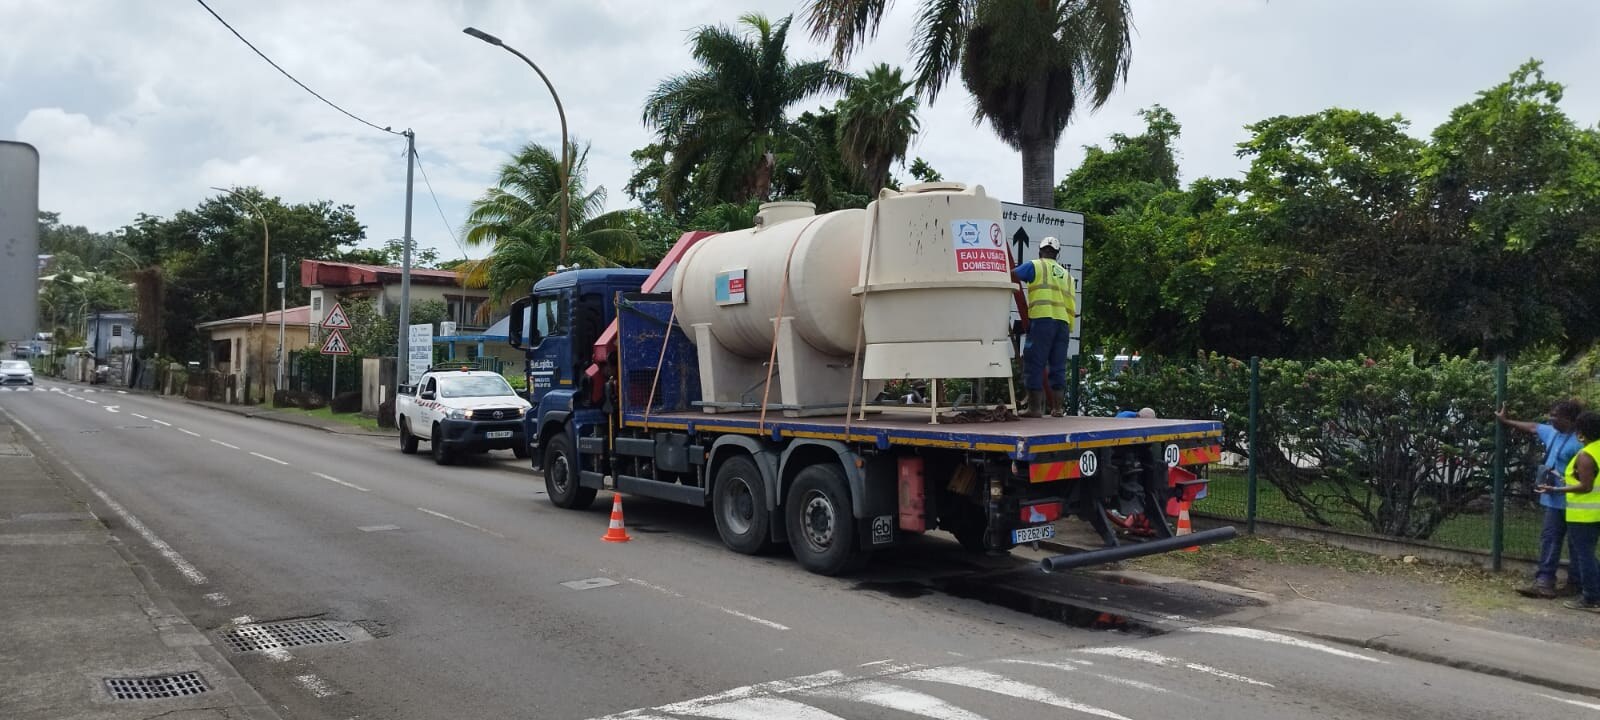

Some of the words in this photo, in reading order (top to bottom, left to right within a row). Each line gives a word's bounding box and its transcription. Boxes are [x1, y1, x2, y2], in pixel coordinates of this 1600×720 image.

[1002, 211, 1017, 221] uts
[1021, 211, 1033, 222] du
[1037, 213, 1065, 227] Morne
[960, 251, 978, 260] EAU
[986, 251, 1005, 261] USAGE
[962, 261, 1006, 272] DOMESTIQUE
[1082, 453, 1095, 473] 80
[1167, 447, 1178, 463] 90
